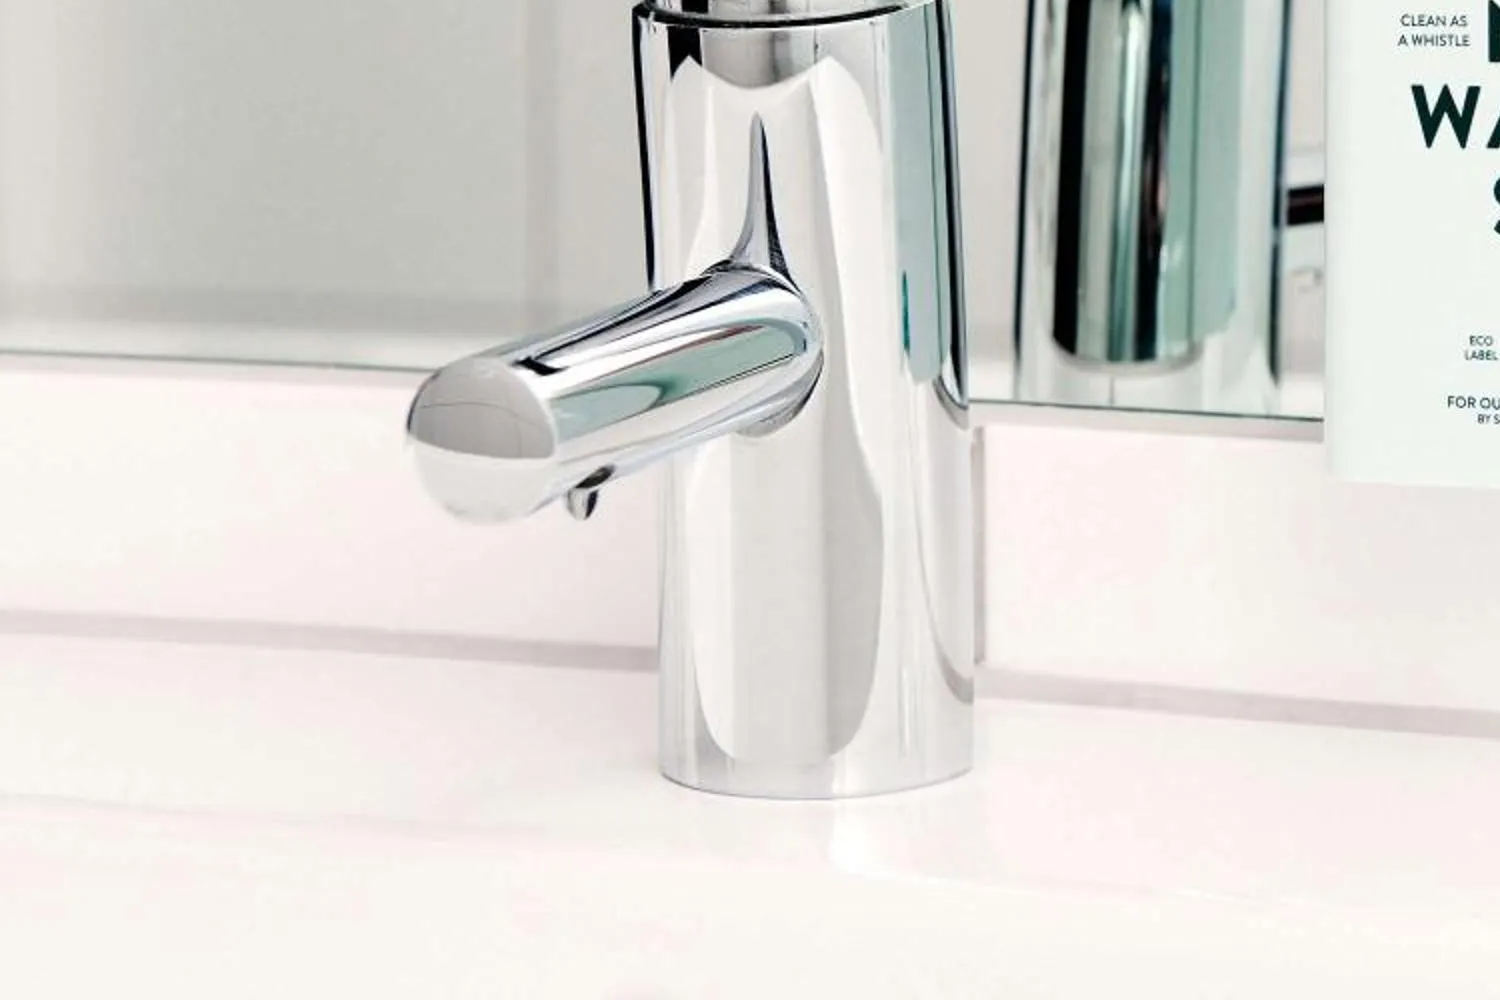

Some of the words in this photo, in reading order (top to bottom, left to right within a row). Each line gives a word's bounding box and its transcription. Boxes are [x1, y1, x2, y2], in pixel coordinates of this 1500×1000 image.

[1400, 14, 1447, 27] CLEAN
[1449, 15, 1468, 27] AS
[1397, 34, 1409, 47] A
[1411, 34, 1470, 48] WHISTLE
[1469, 335, 1494, 347] ECO
[1464, 349, 1499, 361] LABEL
[1447, 395, 1477, 409] FOR
[1477, 413, 1491, 425] BY
